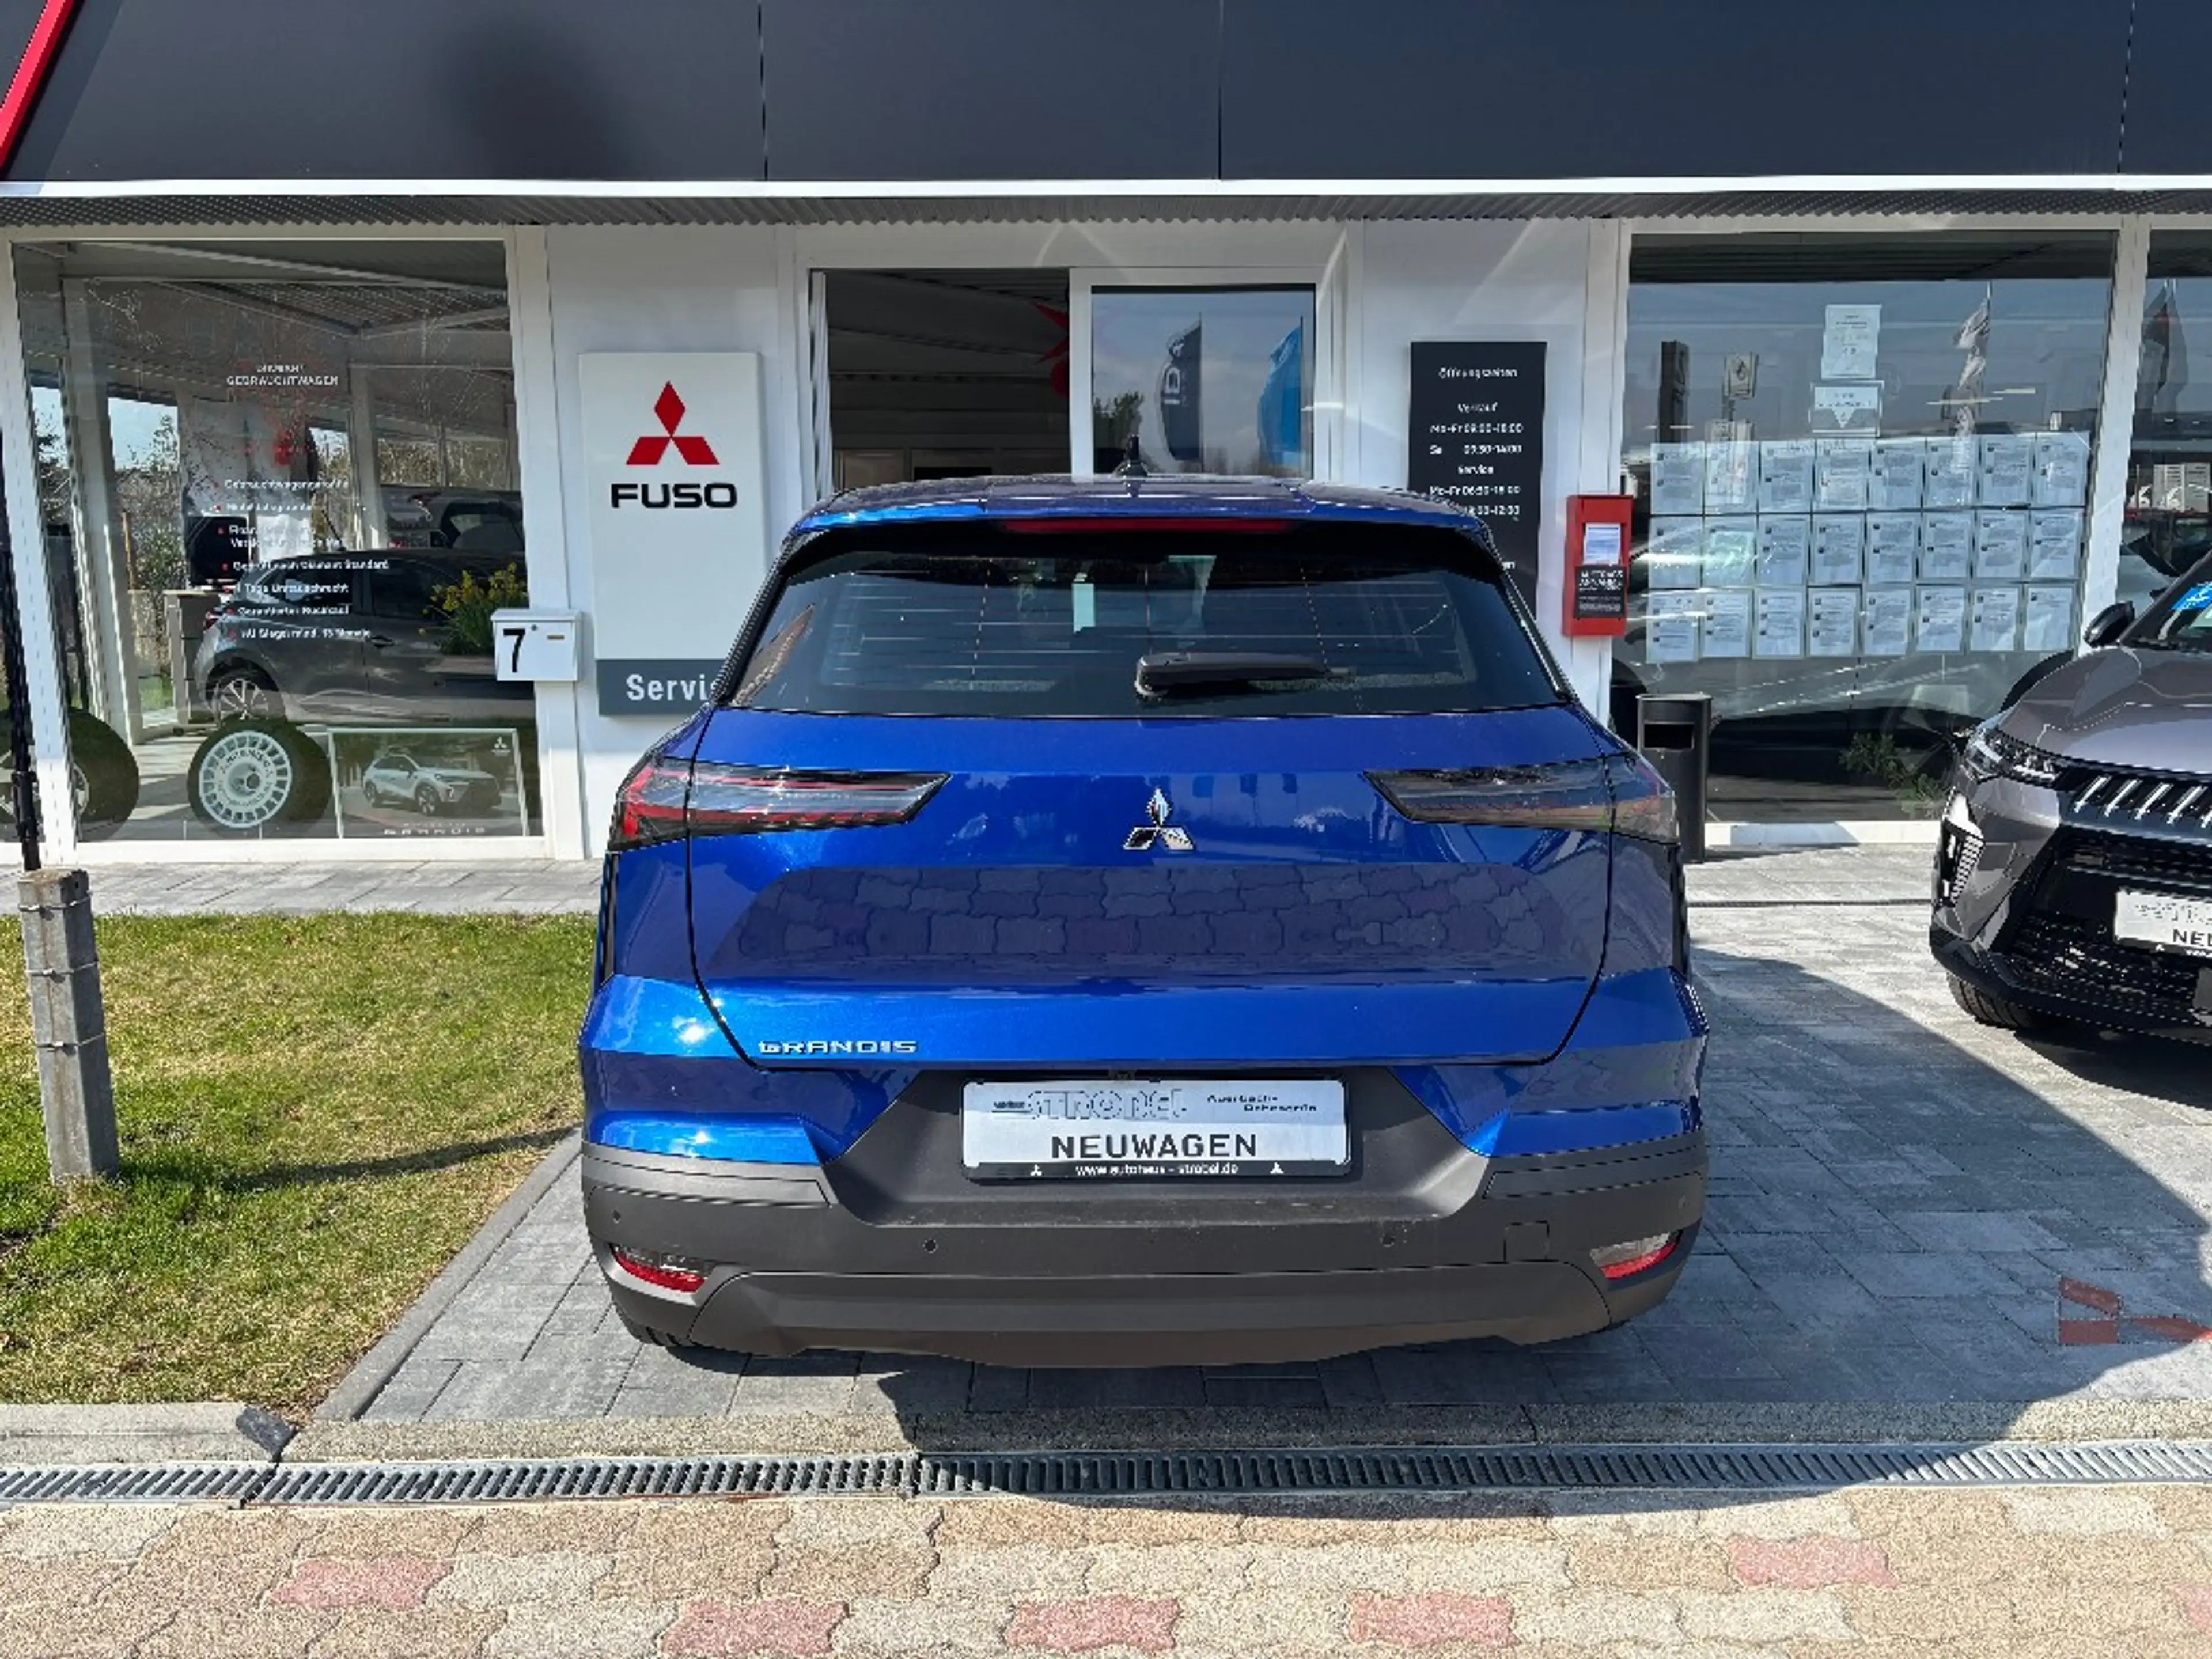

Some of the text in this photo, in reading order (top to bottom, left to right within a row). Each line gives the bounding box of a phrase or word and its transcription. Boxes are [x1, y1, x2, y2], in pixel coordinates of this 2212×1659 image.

[611, 483, 737, 509] FUSO
[503, 628, 526, 673] 7
[626, 673, 718, 702] Servi
[758, 1040, 917, 1054] GRANDIS
[1051, 1134, 1257, 1158] NEUWAGEN
